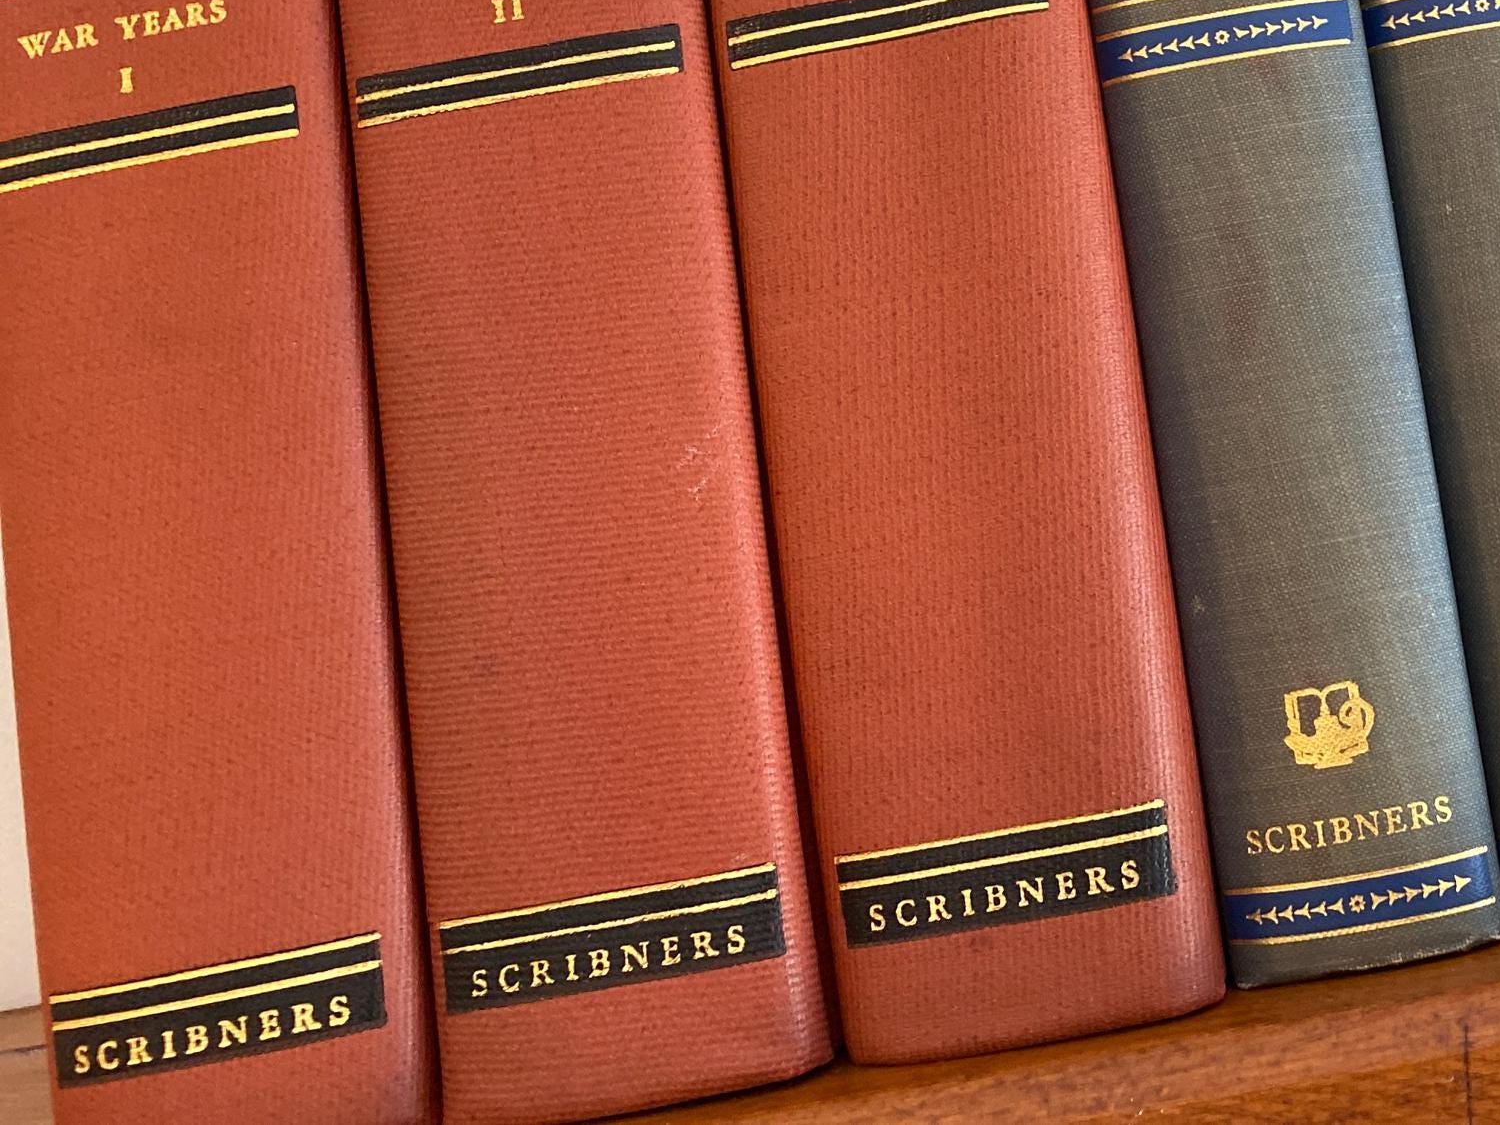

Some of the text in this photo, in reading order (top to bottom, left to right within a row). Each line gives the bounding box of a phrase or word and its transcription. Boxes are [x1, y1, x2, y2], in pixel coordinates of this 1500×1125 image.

[16, 23, 99, 59] WAR
[119, 66, 133, 94] I
[1246, 795, 1453, 854] SCRIBNERS
[869, 859, 1140, 932] SCRIBNERS
[471, 924, 746, 997] SCRIBNERS
[74, 995, 351, 1074] SCRIBNERS
